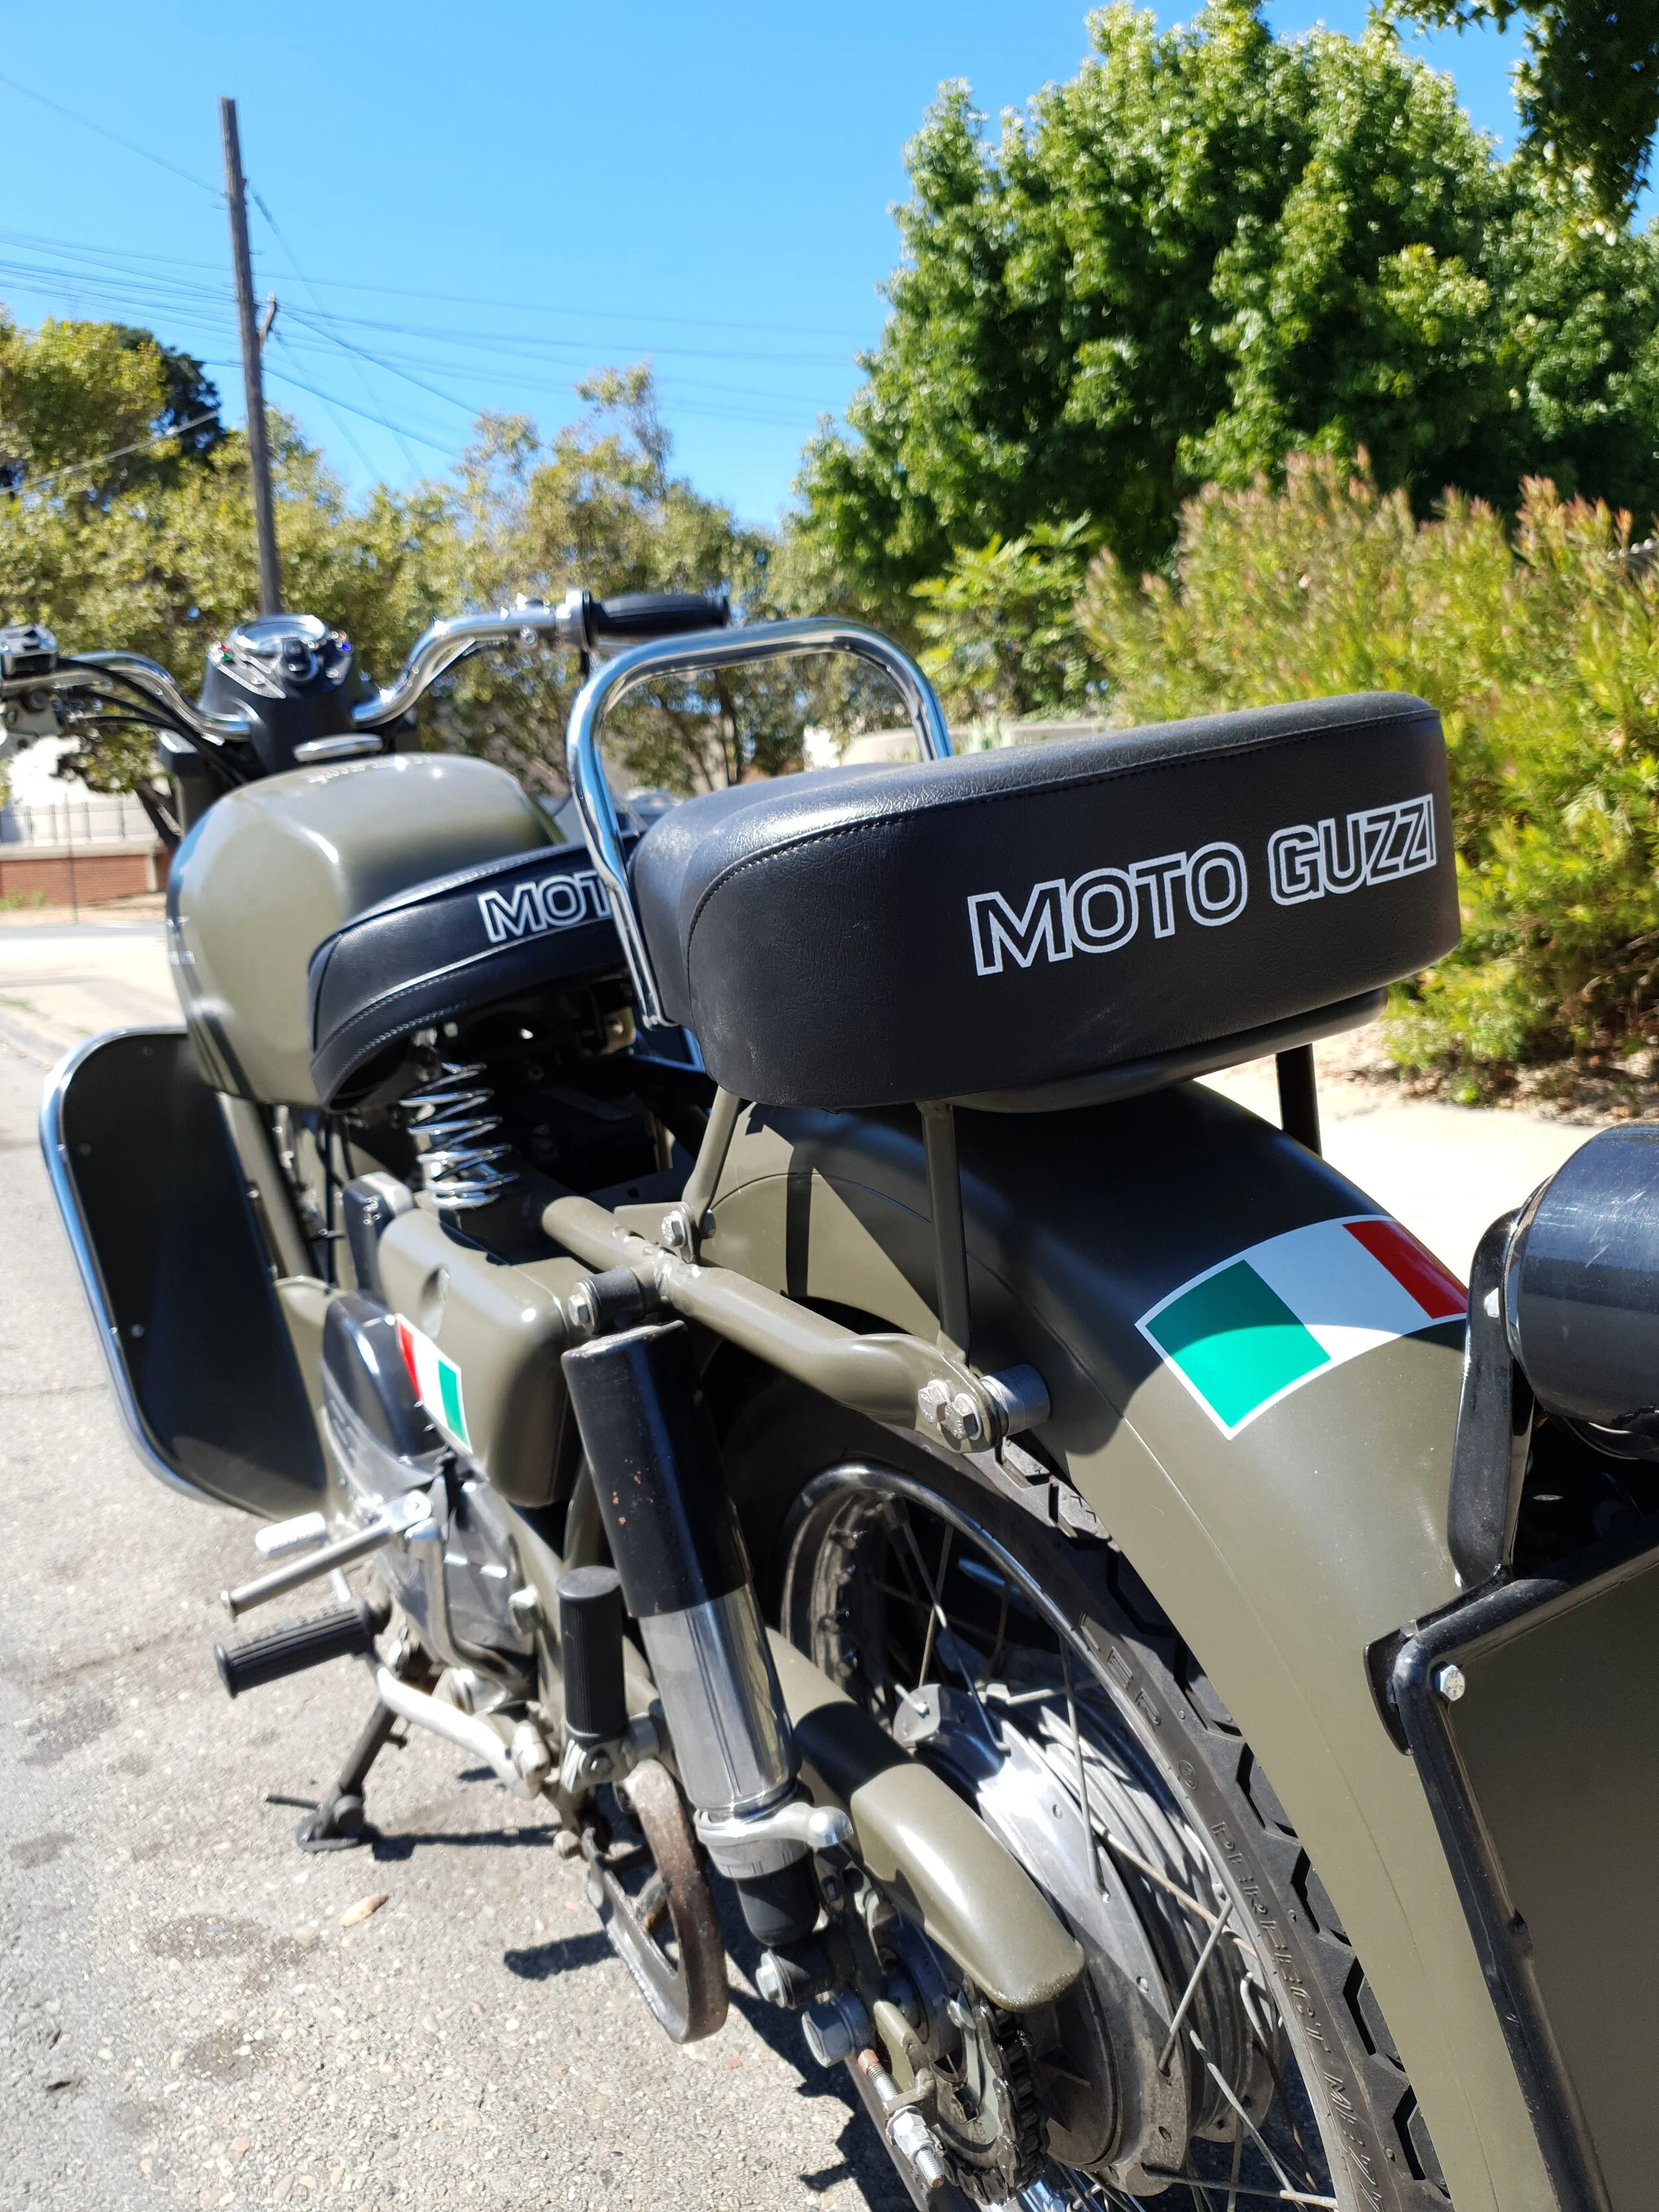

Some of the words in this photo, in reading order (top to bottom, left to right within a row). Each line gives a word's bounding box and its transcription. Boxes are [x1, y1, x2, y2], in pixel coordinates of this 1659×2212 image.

[477, 869, 612, 943] MOT
[968, 841, 1248, 976] MOTO
[1266, 794, 1437, 906] GUZZI
